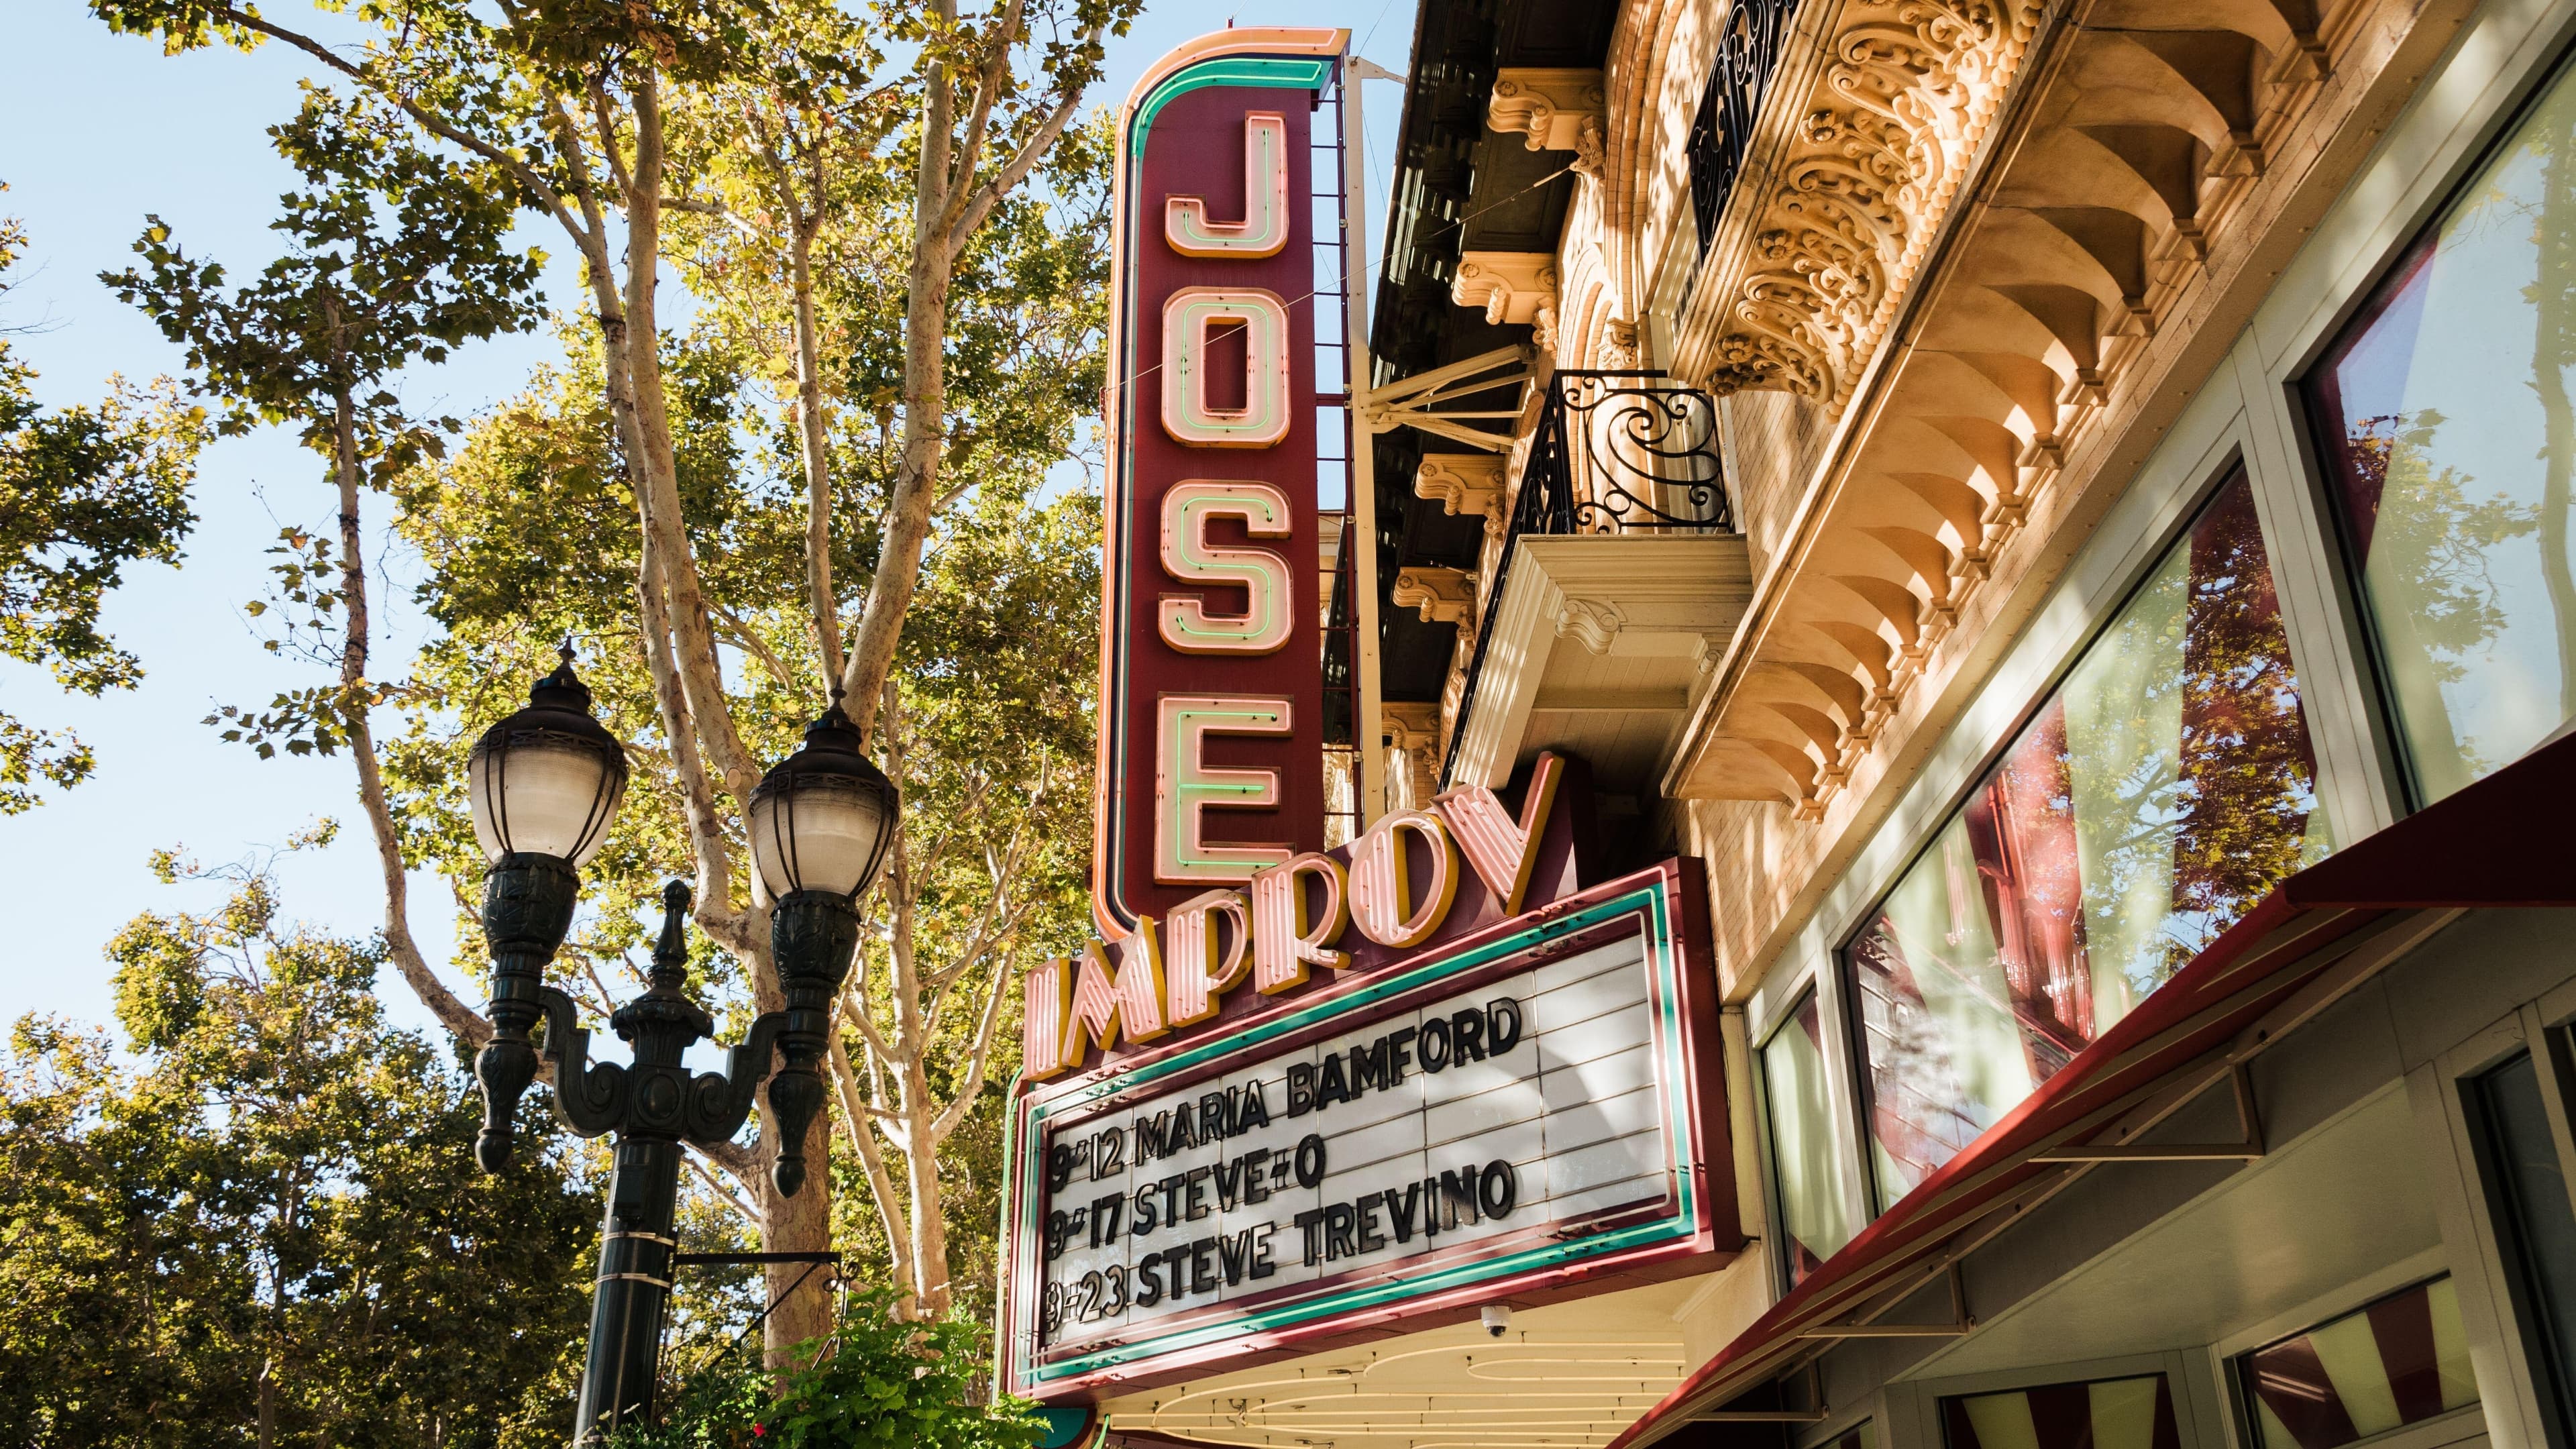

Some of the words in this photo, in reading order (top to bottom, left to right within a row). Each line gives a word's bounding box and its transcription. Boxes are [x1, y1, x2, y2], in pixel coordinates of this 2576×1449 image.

[1154, 110, 1296, 885] JOSE
[1023, 751, 1565, 1081] IMPROV
[1049, 1126, 1123, 1193] 9-12
[1135, 1079, 1269, 1167] MARIA
[1287, 997, 1521, 1119] BAMFORD
[1045, 1191, 1123, 1260] 9-17
[1132, 1134, 1326, 1236] STEVE-O
[1045, 1264, 1126, 1332] 9-23
[1136, 1221, 1275, 1307] STEVE
[1294, 1159, 1516, 1267] TREVINO
